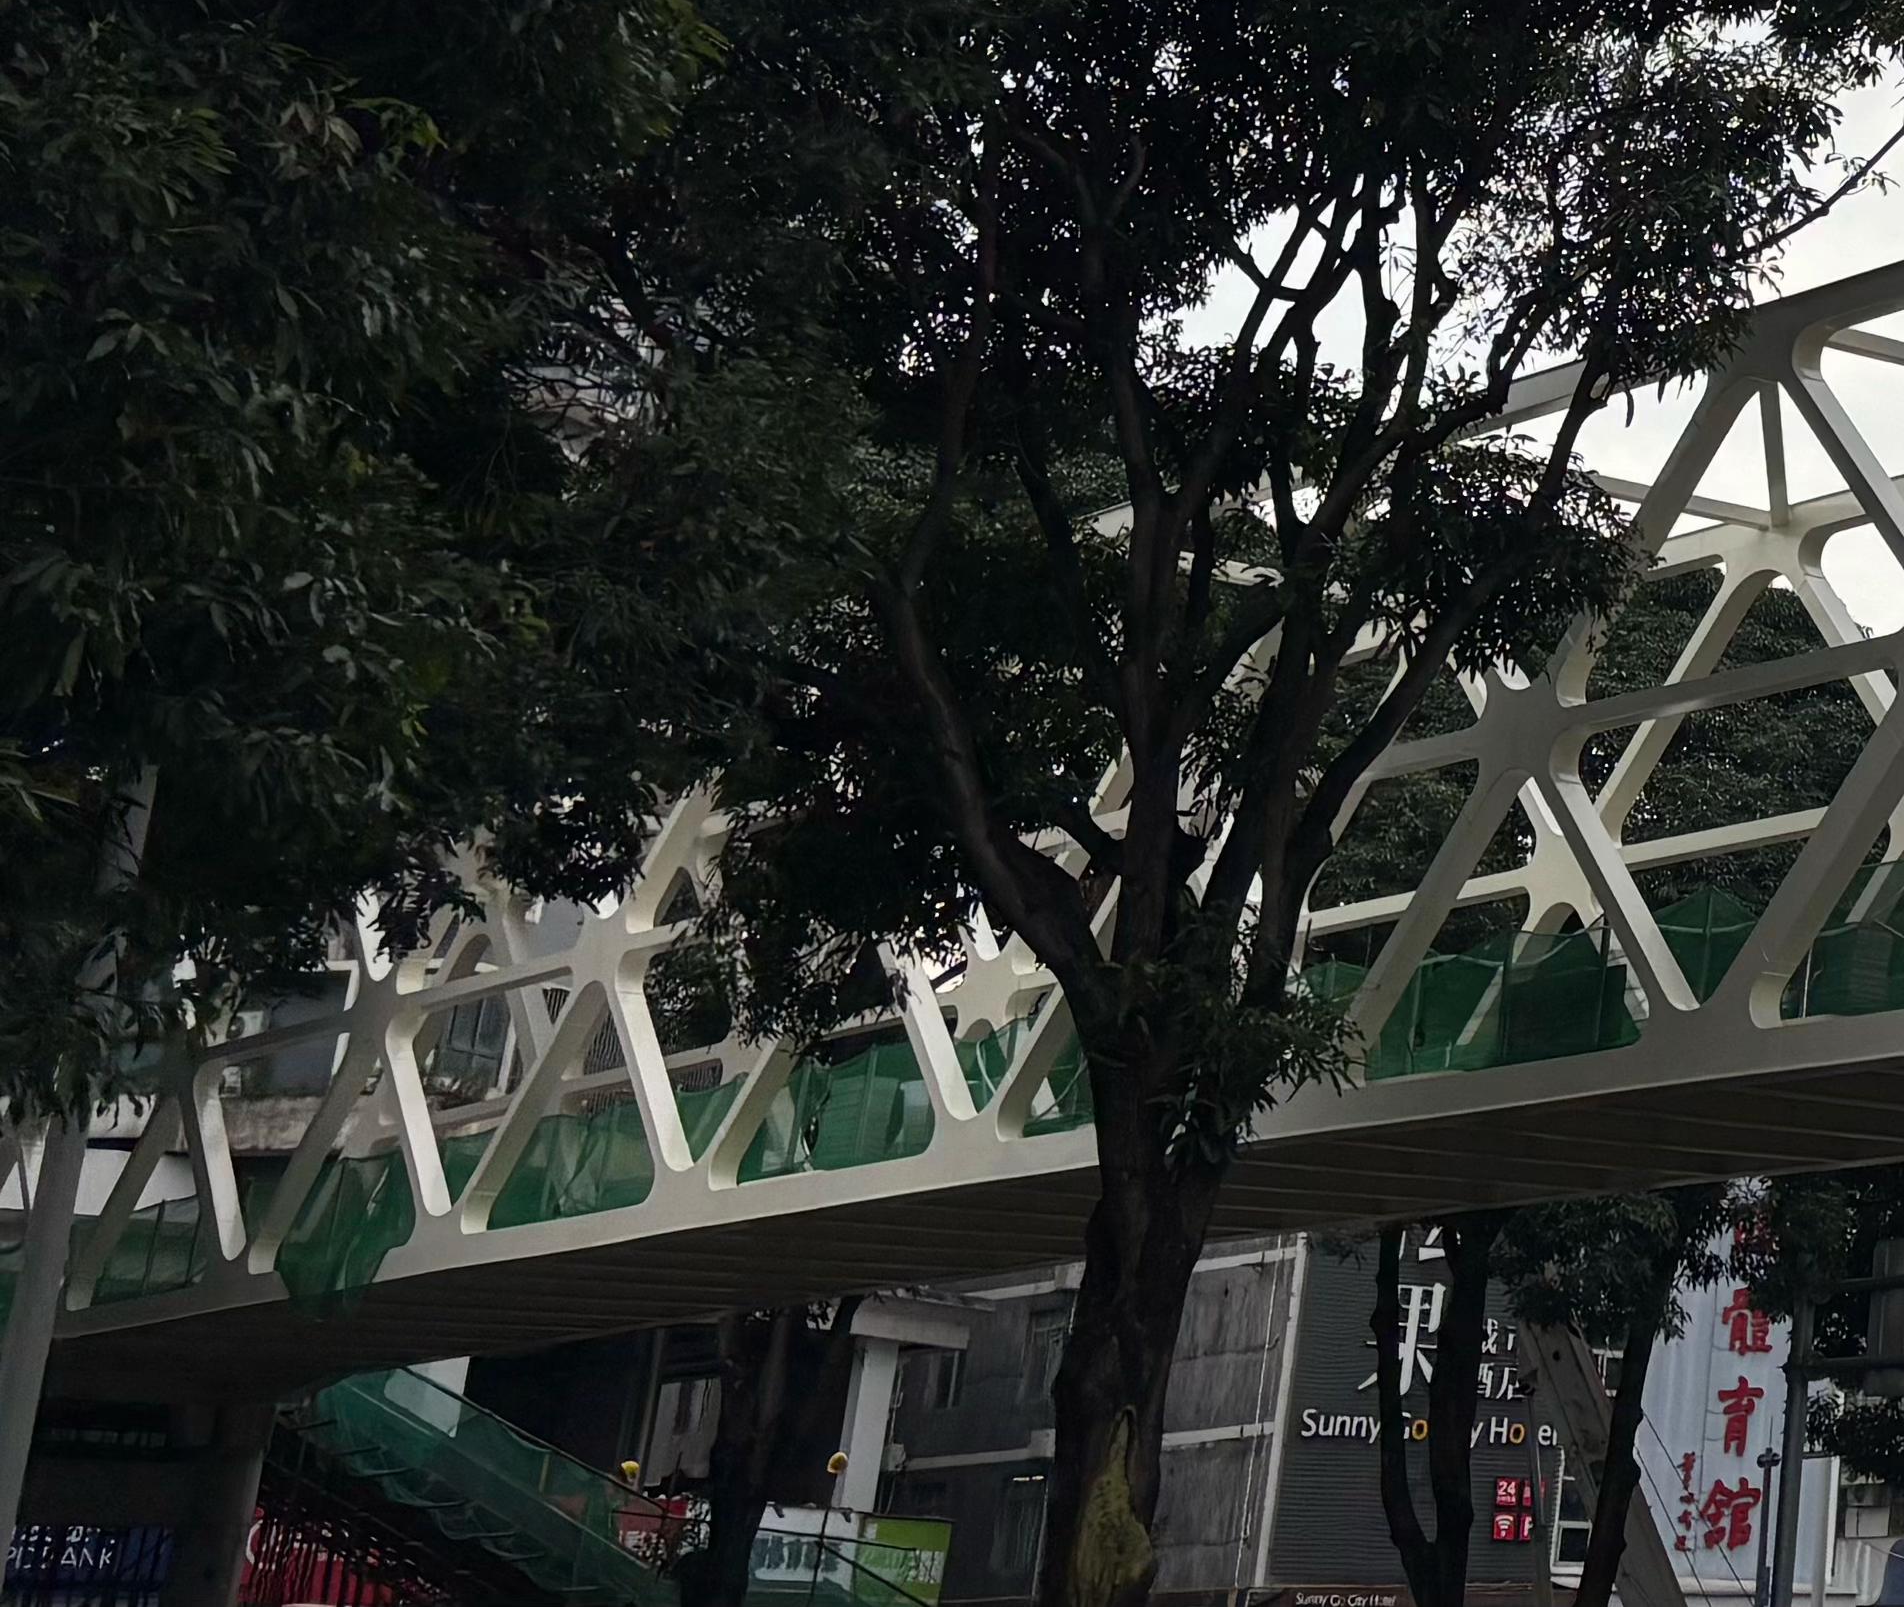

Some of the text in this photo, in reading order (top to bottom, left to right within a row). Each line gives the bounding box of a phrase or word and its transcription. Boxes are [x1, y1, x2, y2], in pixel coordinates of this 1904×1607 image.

[1700, 1206, 1772, 1551] 體育館
[1301, 1409, 1381, 1443] Sunny
[1498, 1481, 1516, 1495] 24
